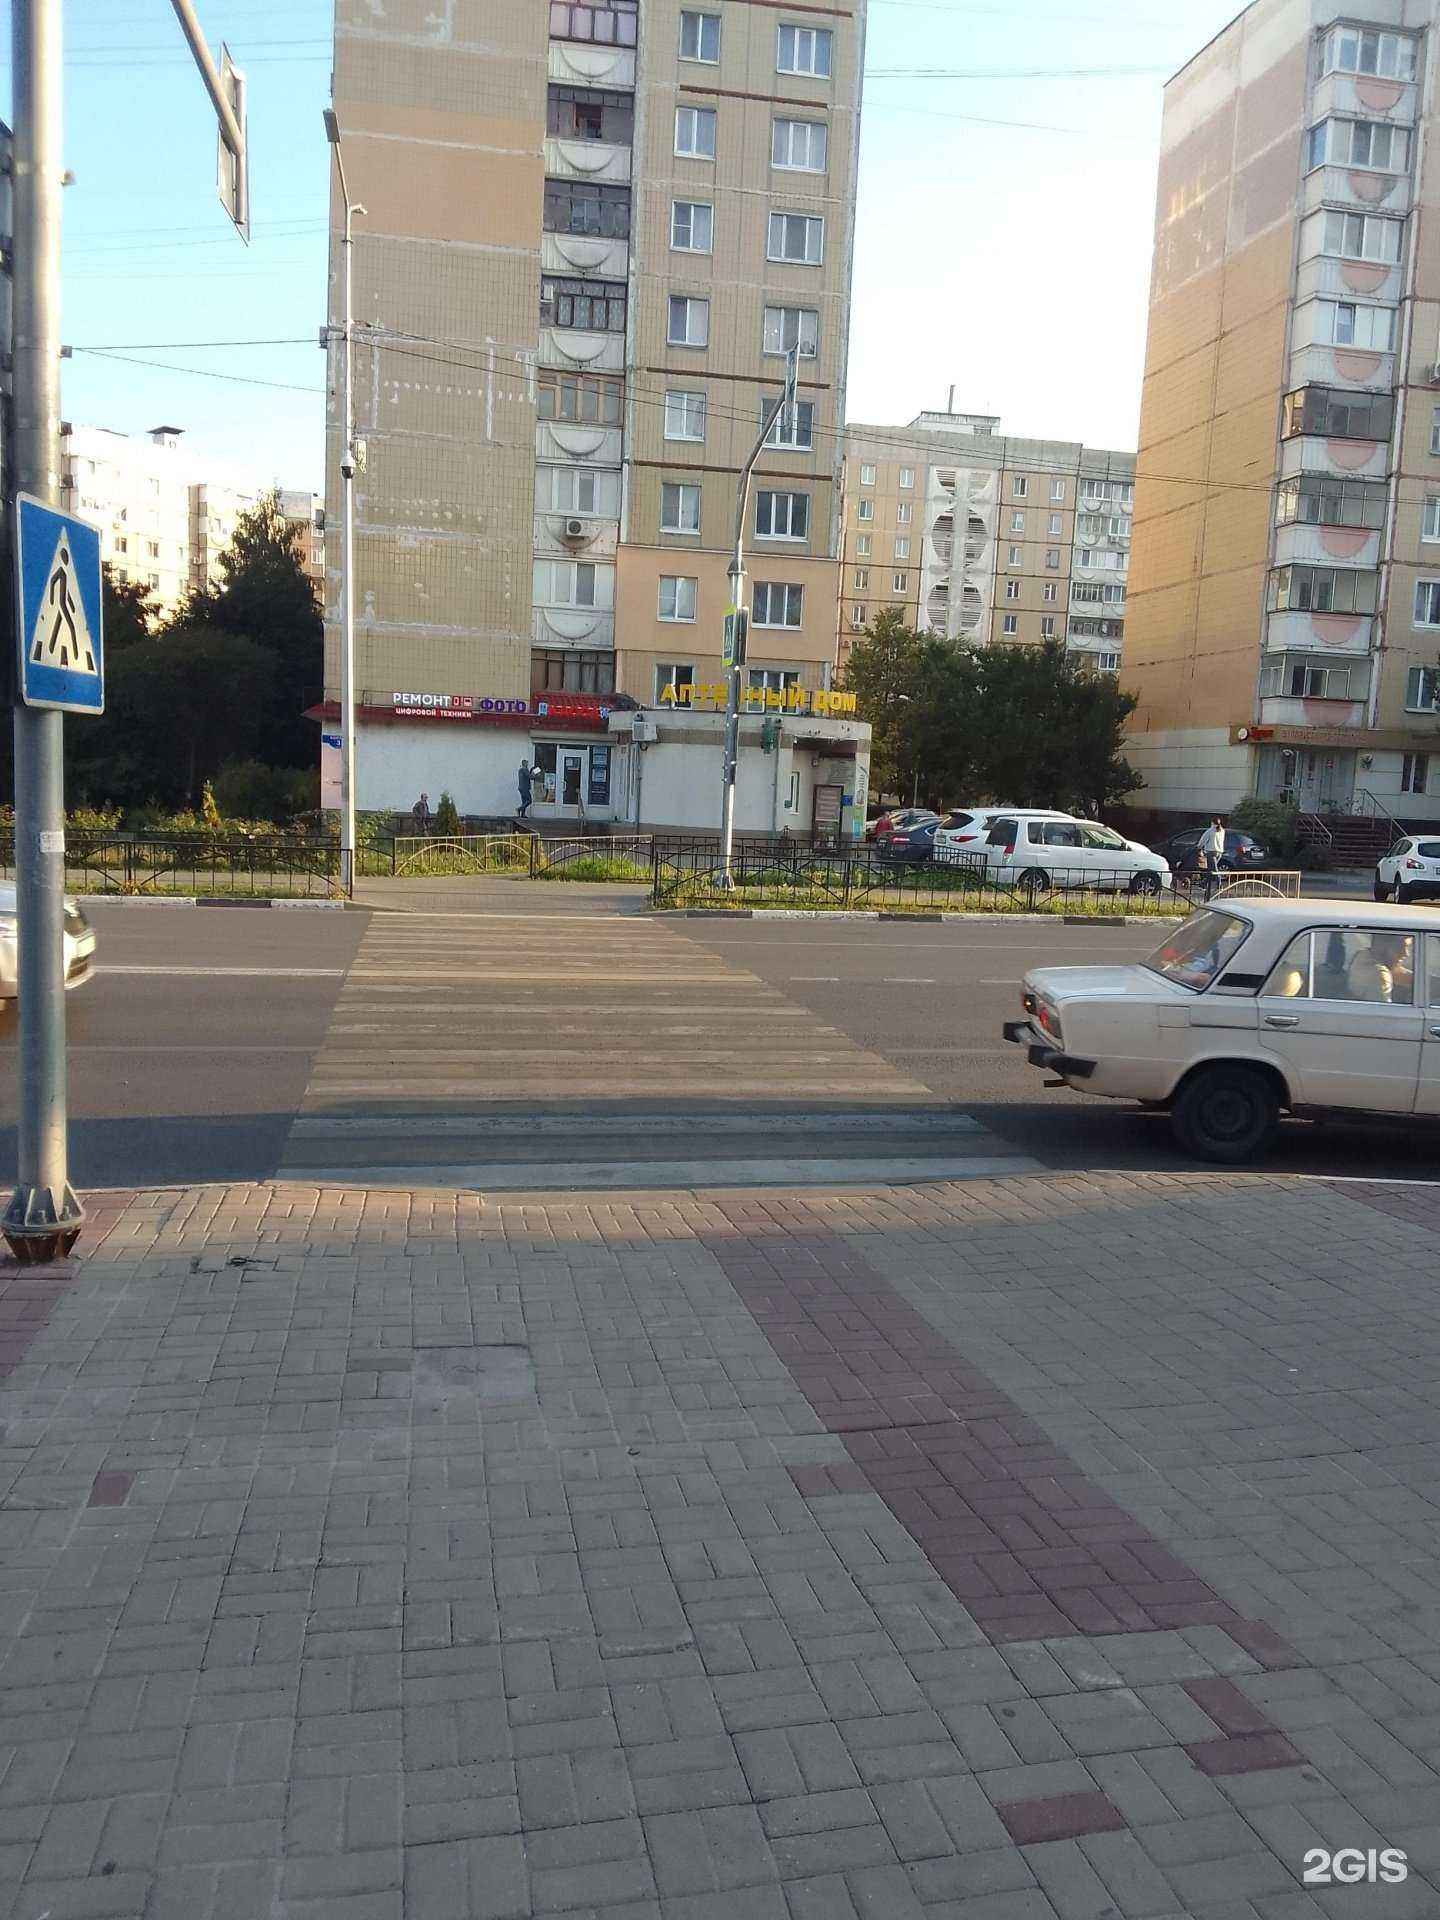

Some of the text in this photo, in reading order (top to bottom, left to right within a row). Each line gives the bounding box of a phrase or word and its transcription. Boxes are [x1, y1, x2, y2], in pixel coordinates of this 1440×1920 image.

[393, 692, 450, 707] РЕМОНТ
[480, 697, 527, 713] ФОТО
[812, 690, 857, 713] ДОМ
[395, 707, 472, 719] ЦИФРОВОЙ ТЕХНИКИ
